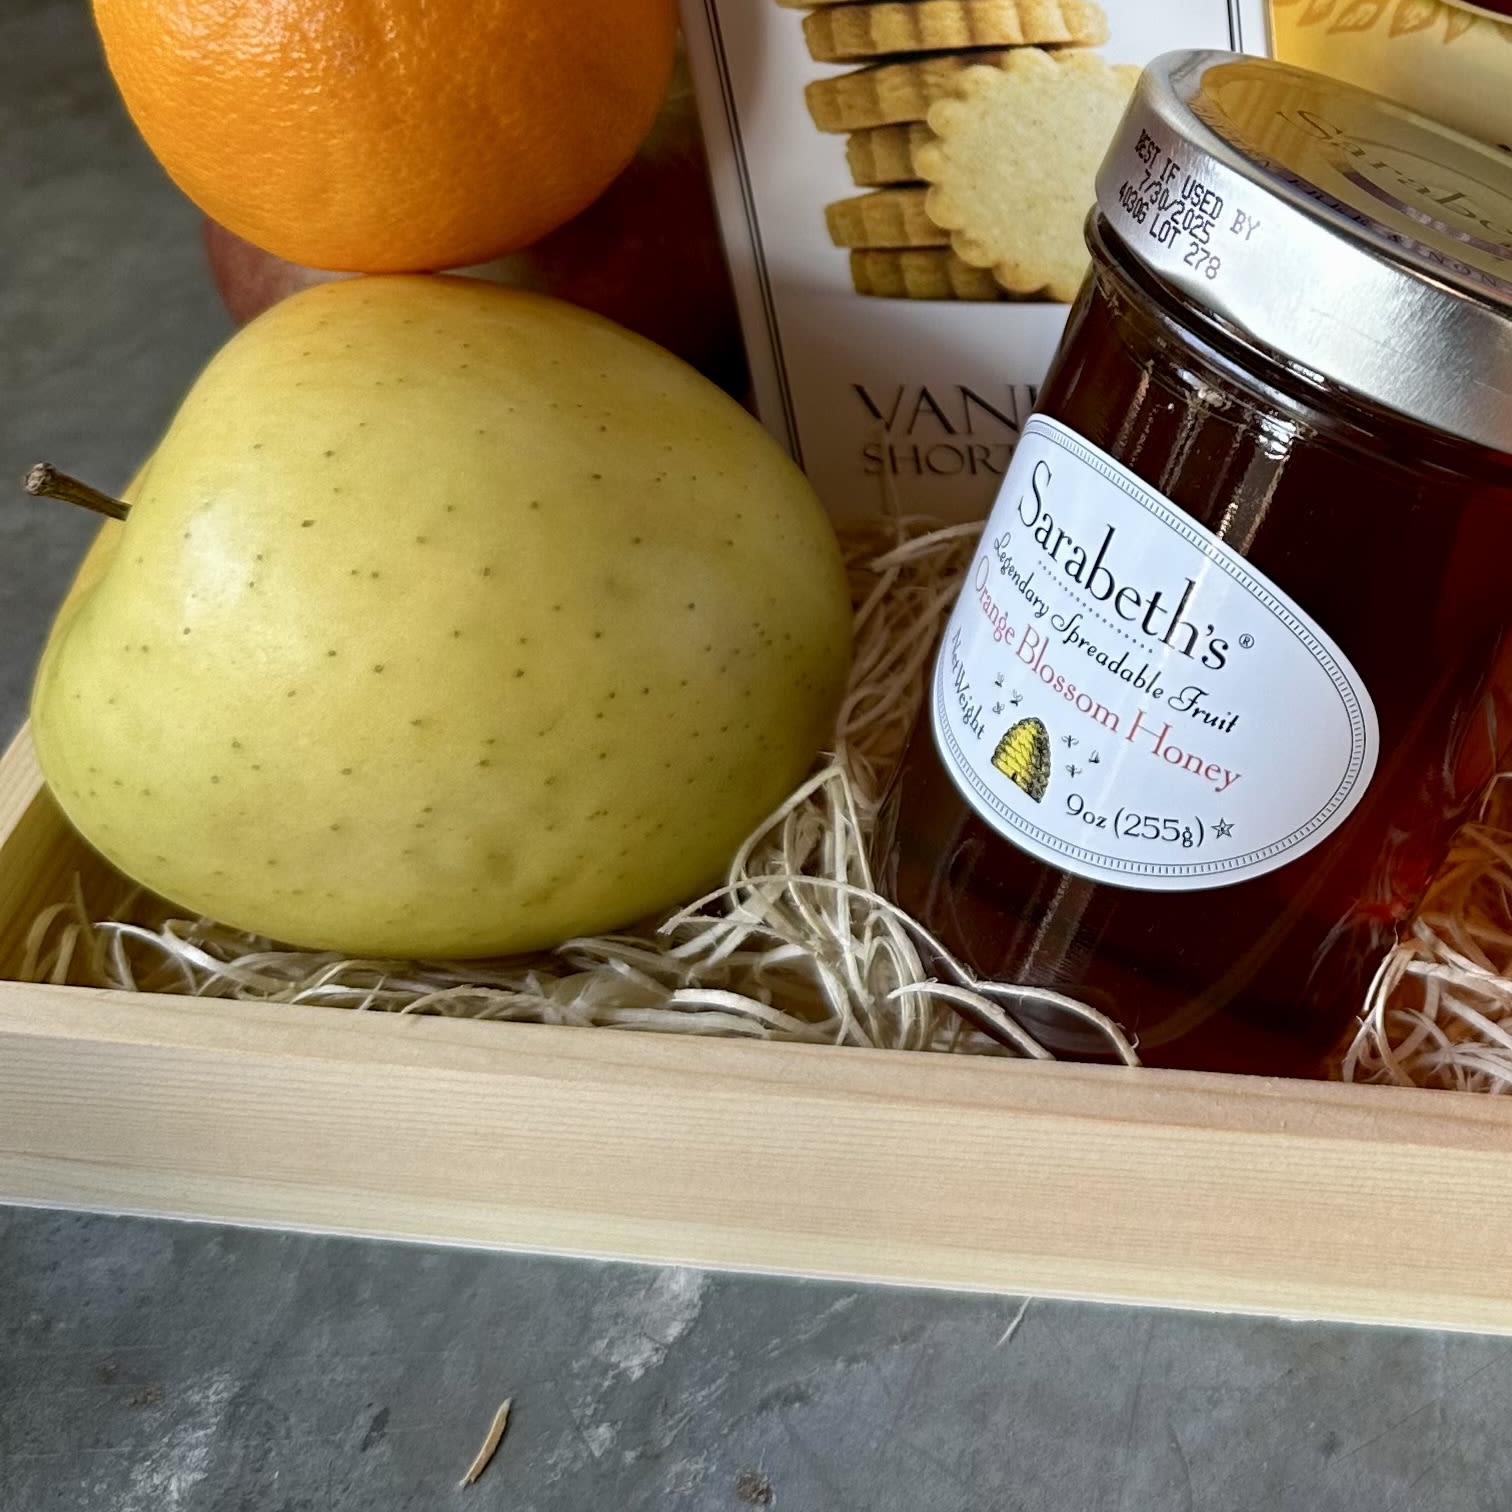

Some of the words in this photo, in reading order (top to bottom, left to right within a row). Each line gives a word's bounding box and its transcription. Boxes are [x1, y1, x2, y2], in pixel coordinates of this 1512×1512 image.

[1140, 169, 1216, 245] 7/30/2025
[1160, 157, 1180, 185] IF
[1181, 175, 1224, 220] USED
[1229, 208, 1261, 241] BY
[1149, 213, 1182, 249] LOT
[1183, 241, 1222, 280] 278
[973, 555, 1016, 647] Orange
[1015, 624, 1121, 733] Blossom
[1126, 711, 1243, 794] Honey
[993, 532, 1050, 619] Legendary
[1050, 613, 1164, 701] Spreadable
[1168, 684, 1241, 736] Fruit
[955, 660, 986, 741] Weight
[1064, 792, 1108, 831] 9oz
[1113, 806, 1206, 850] (255g)
